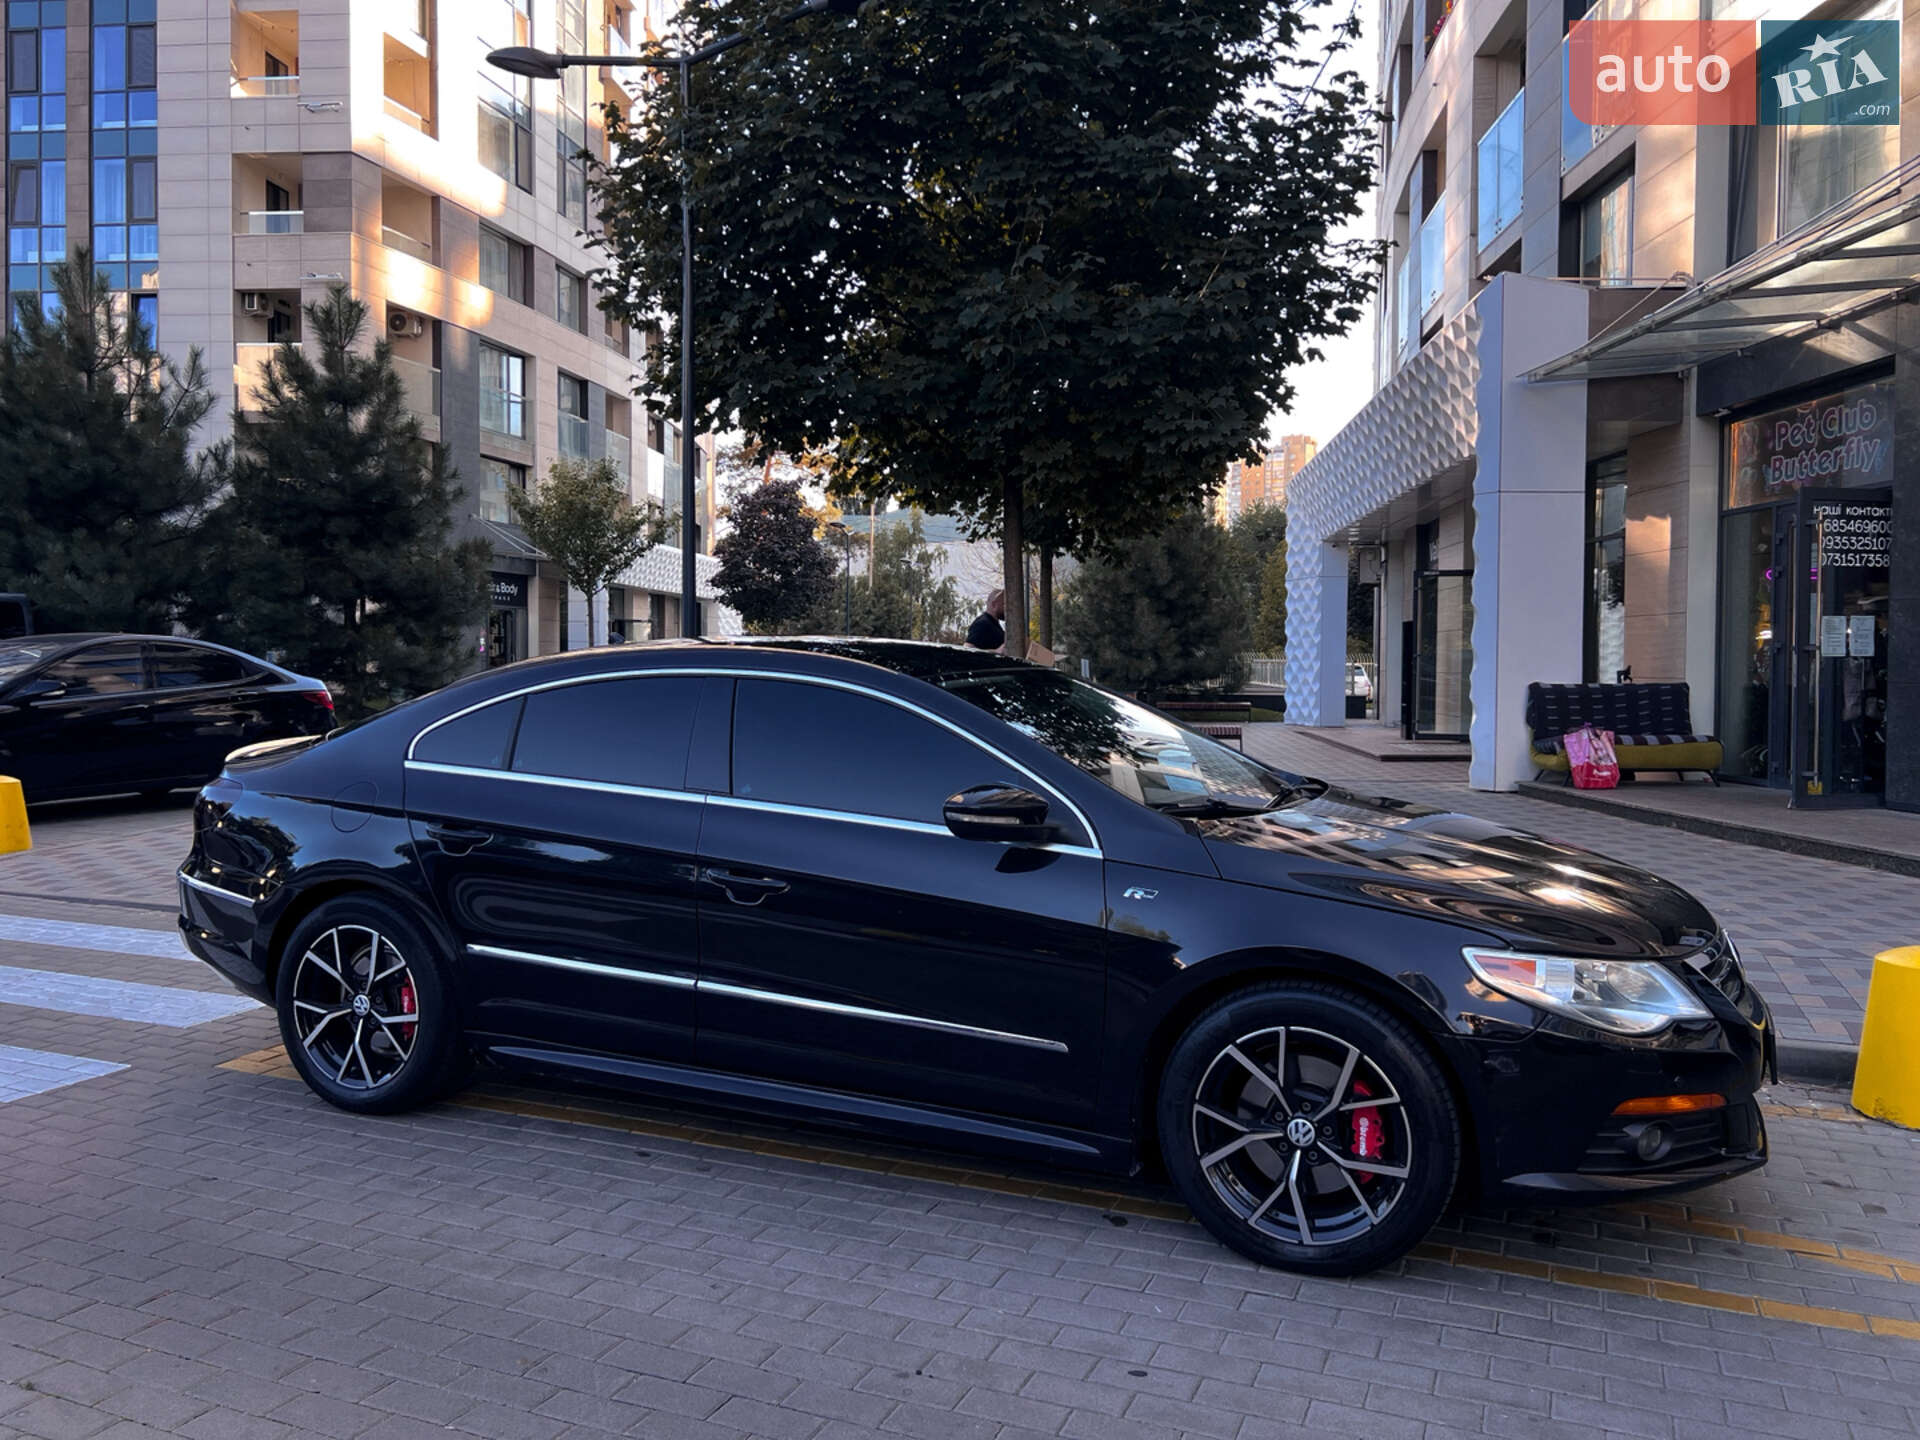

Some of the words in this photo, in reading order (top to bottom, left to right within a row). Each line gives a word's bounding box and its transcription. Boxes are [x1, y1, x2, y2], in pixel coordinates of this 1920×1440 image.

[1775, 415, 1816, 451] Pet
[1821, 399, 1876, 438] Club
[1770, 436, 1880, 484] Butterfly
[500, 582, 518, 596] Body
